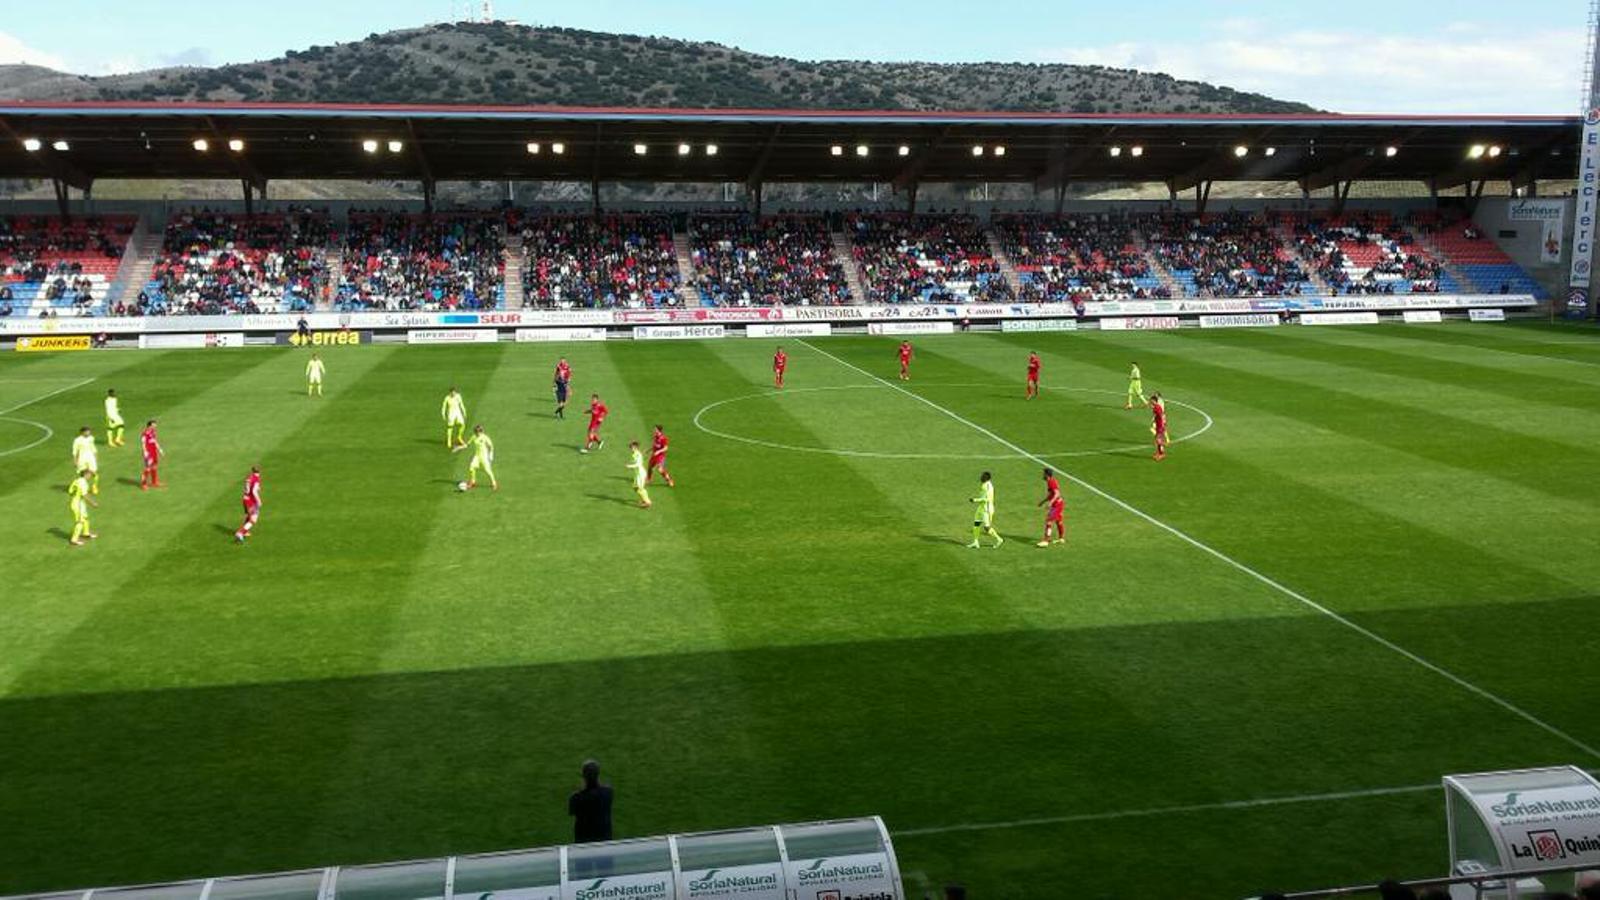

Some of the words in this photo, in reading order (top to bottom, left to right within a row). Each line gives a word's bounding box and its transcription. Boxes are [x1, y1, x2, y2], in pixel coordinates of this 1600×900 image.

[480, 314, 522, 324] SEUR
[796, 308, 863, 319] PASTISORIA
[652, 329, 681, 337] Grupo
[684, 326, 723, 336] Herce
[32, 339, 89, 348] JUNKERS
[1511, 843, 1534, 858] La
[798, 862, 883, 880] SoriaNatural
[689, 873, 777, 891] SoriaNatural
[576, 881, 666, 900] SoriaNatural
